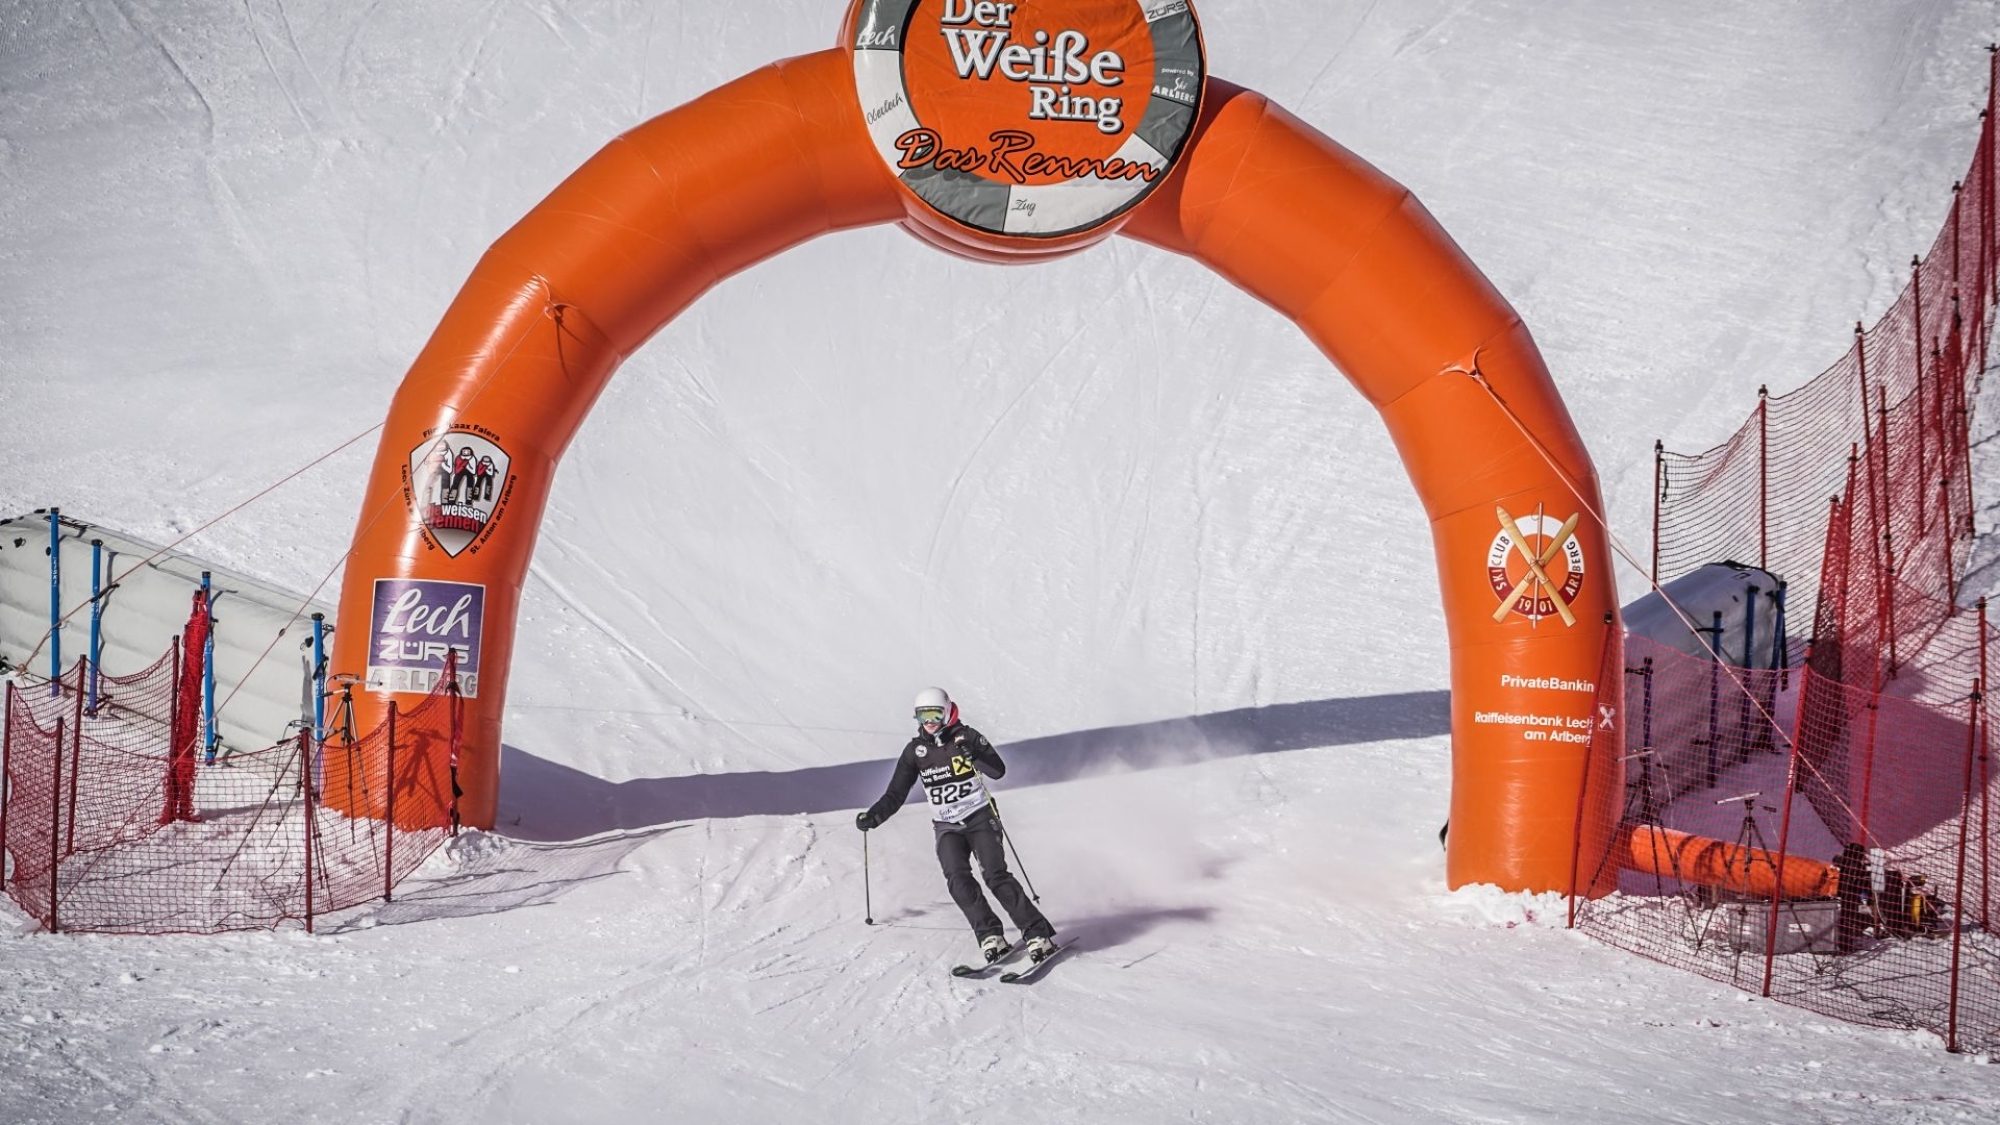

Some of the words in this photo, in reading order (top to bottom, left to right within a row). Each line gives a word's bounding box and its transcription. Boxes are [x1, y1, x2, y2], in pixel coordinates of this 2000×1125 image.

[941, 0, 1016, 28] Der
[941, 27, 1124, 87] Weiße
[1161, 67, 1186, 76] powered
[1187, 69, 1195, 77] by
[1152, 84, 1195, 104] ARLBERG
[1174, 77, 1188, 92] Ski
[1029, 84, 1124, 135] Ring
[895, 128, 986, 174] Das
[988, 129, 1160, 184] Rennen
[1010, 198, 1037, 217] Zug
[449, 422, 471, 430] Laax
[473, 424, 501, 442] Falera
[429, 515, 480, 534] rennen
[470, 545, 481, 555] St.
[480, 521, 498, 545] Anton
[495, 507, 505, 521] am
[501, 474, 517, 507] Arlberg
[1564, 541, 1581, 597] ARLBERG
[380, 588, 472, 638] Lech
[379, 639, 470, 664] ZÜRS
[1501, 674, 1594, 692] PrivateBankin
[1474, 711, 1563, 727] Raiffeisenbank
[1524, 731, 1546, 741] am
[932, 771, 952, 781] Bank
